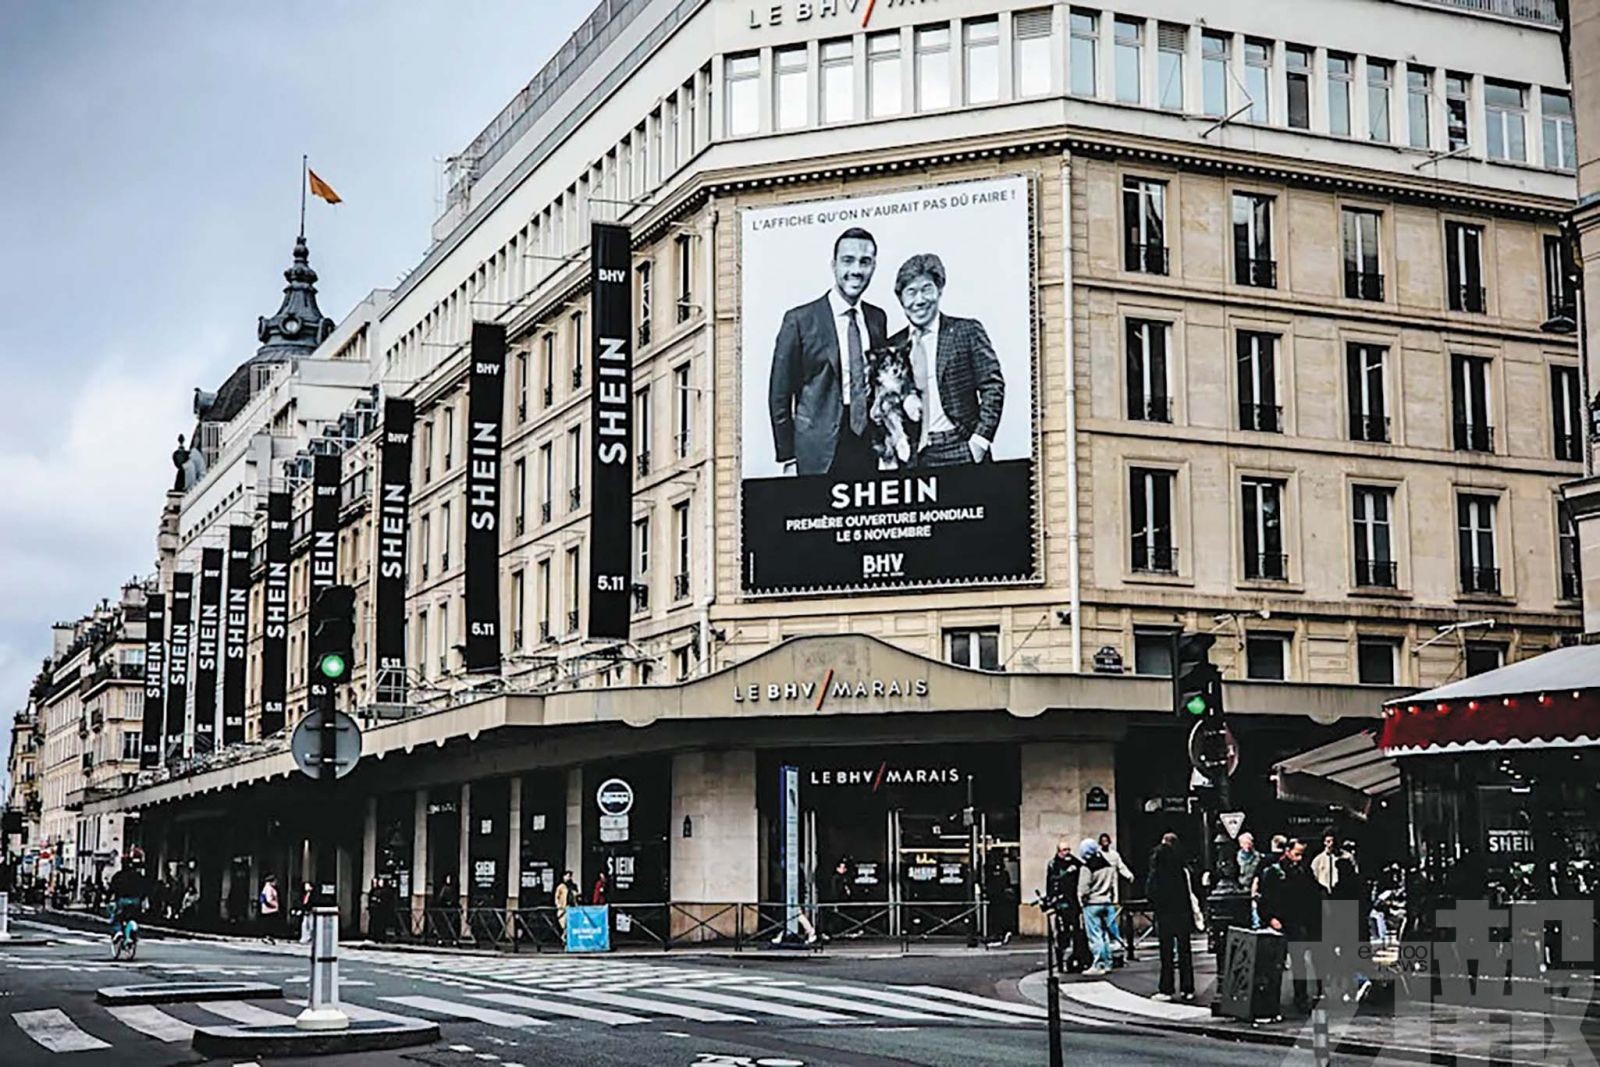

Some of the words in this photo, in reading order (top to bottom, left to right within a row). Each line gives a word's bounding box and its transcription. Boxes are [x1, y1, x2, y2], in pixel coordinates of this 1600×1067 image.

[749, 6, 782, 29] LE
[752, 214, 814, 231] L'AFFICHE
[817, 209, 858, 224] QU'ON
[861, 201, 919, 218] N'AURAIT
[923, 198, 948, 210] PAS
[950, 193, 969, 207] DÛ
[972, 190, 1008, 204] FAIRE
[598, 268, 626, 283] BHV
[476, 362, 500, 375] BHV
[598, 337, 627, 465] SHEIN
[471, 422, 497, 530] SHEIN
[831, 477, 938, 509] SHEIN
[382, 485, 405, 579] SHEIN
[786, 515, 844, 531] PREMIÈRE
[845, 511, 917, 527] OUVERTURE
[919, 506, 984, 522] MONDIALE
[836, 530, 851, 542] LE
[864, 525, 931, 541] NOVEMBRE
[313, 532, 335, 586] EIN
[863, 553, 904, 573] BHV
[597, 575, 624, 591] 5.11
[266, 563, 287, 638] SHEIN
[200, 605, 217, 670] SHEIN
[228, 589, 246, 658] SHEIN
[471, 622, 495, 636] 5.11
[147, 641, 162, 699] SHEIN
[170, 625, 187, 685] SHEIN
[734, 685, 758, 701] LE
[811, 771, 831, 784] LE
